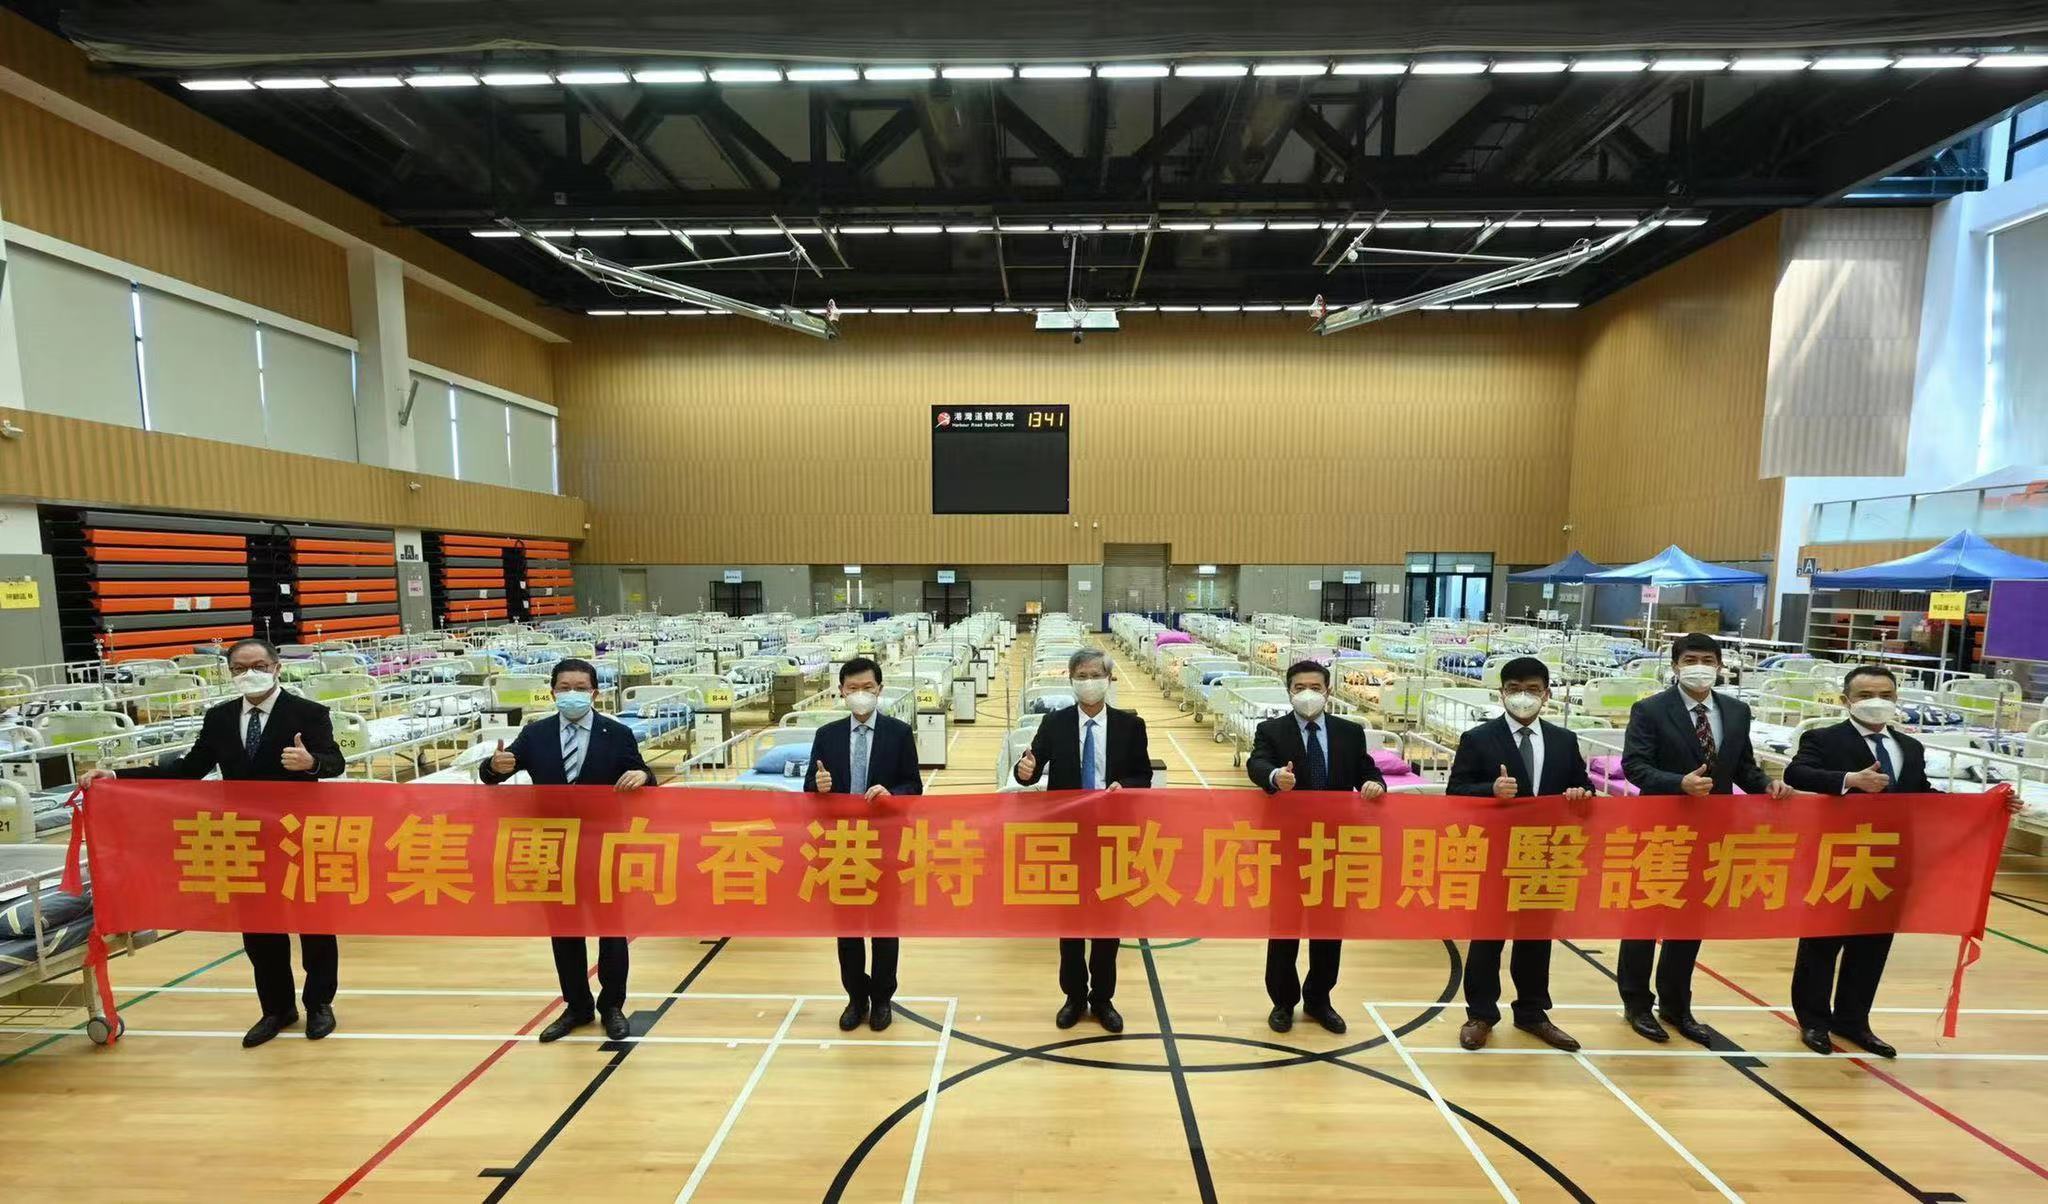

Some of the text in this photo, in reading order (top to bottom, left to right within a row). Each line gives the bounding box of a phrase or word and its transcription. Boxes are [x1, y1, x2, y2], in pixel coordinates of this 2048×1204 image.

[953, 411, 1014, 421] 港灣道體育館
[1028, 411, 1064, 428] 1341
[1804, 559, 1813, 573] A
[534, 694, 550, 702] B-45
[916, 695, 933, 703] B-43
[340, 739, 356, 748] C-9
[172, 810, 1902, 912] 華潤集團向香港特區政府捐贈醫護病床
